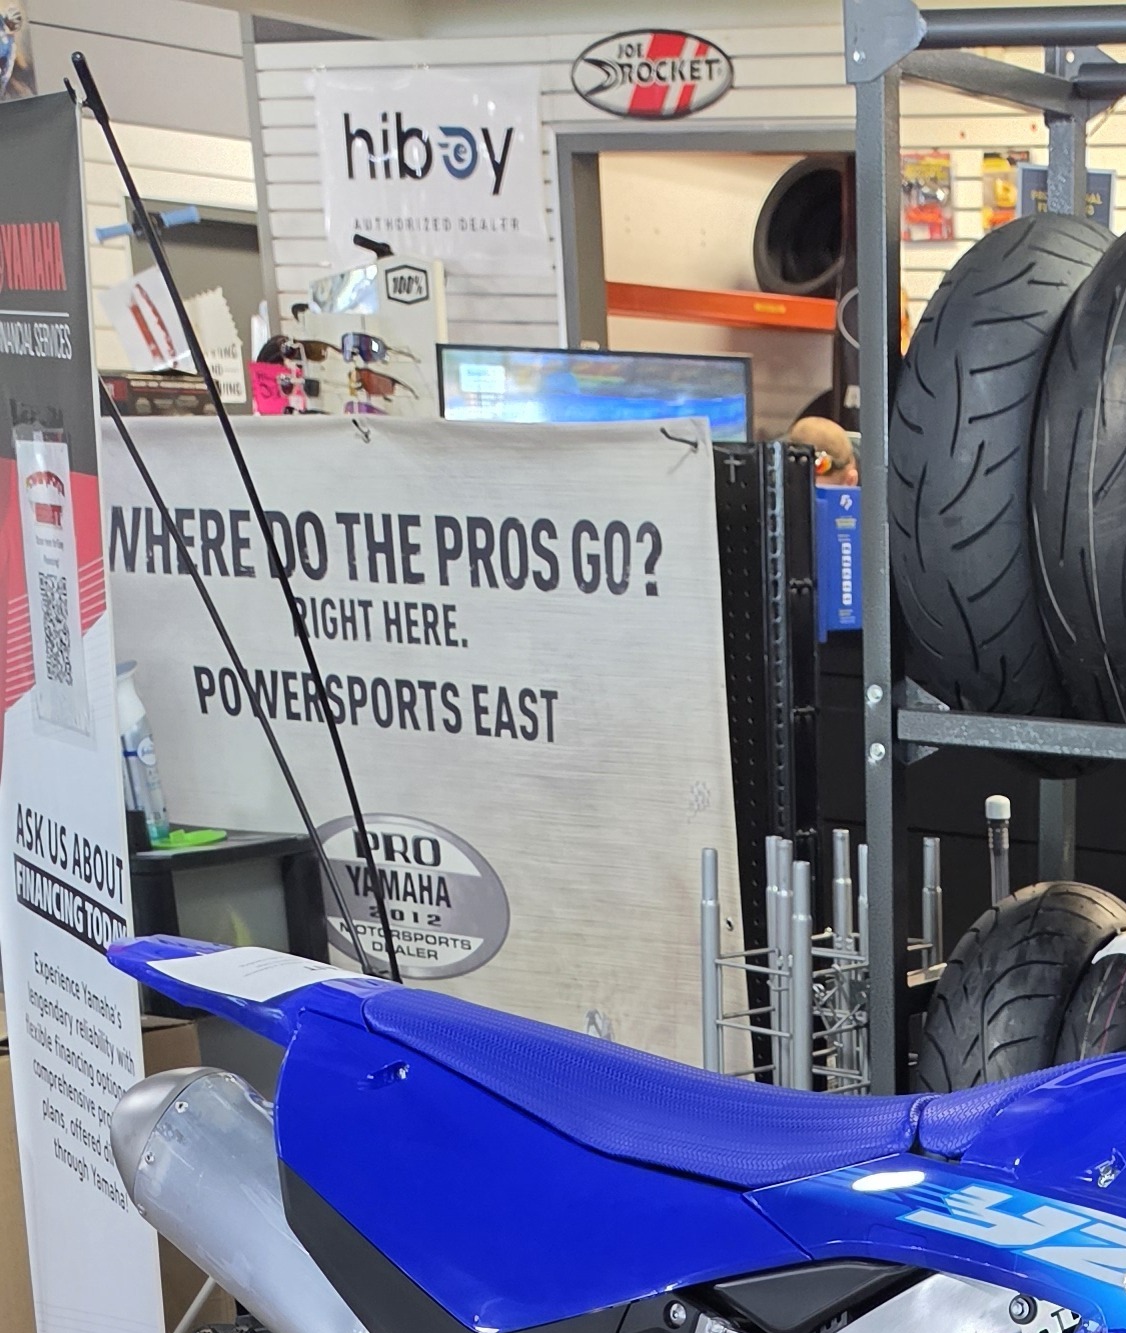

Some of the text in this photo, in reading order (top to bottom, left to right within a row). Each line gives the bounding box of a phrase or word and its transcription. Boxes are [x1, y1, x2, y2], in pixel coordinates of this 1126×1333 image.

[616, 43, 643, 59] JOE
[620, 58, 720, 84] ROCKET
[343, 111, 514, 196] hiboy
[354, 217, 520, 232] AUTHORIZED DEALER
[0, 221, 67, 291] YAMAHA
[392, 275, 423, 295] 100%
[34, 322, 72, 360] SERVICES
[108, 505, 663, 597] WHERE DO THE PROS GO?
[293, 596, 469, 648] RIGHT HERE.
[193, 664, 559, 743] POWERSPORTS EAST
[16, 803, 124, 905] ASK US ABOUT
[352, 828, 442, 867] PRO
[15, 860, 84, 934] FINANCING
[345, 864, 452, 908] YAMAHA
[369, 905, 442, 928] 2012
[372, 941, 438, 960] DALER
[34, 951, 122, 1030] Experience Yamaha's
[25, 1011, 53, 1053] flexible
[54, 1033, 95, 1087] financing
[75, 1018, 115, 1065] reliability
[116, 1046, 136, 1077] with
[33, 1058, 96, 1118] comprehensive
[42, 1097, 68, 1135] plans,
[70, 1117, 101, 1157] offered
[53, 1137, 90, 1184] through
[90, 1163, 129, 1213] Yamaha!
